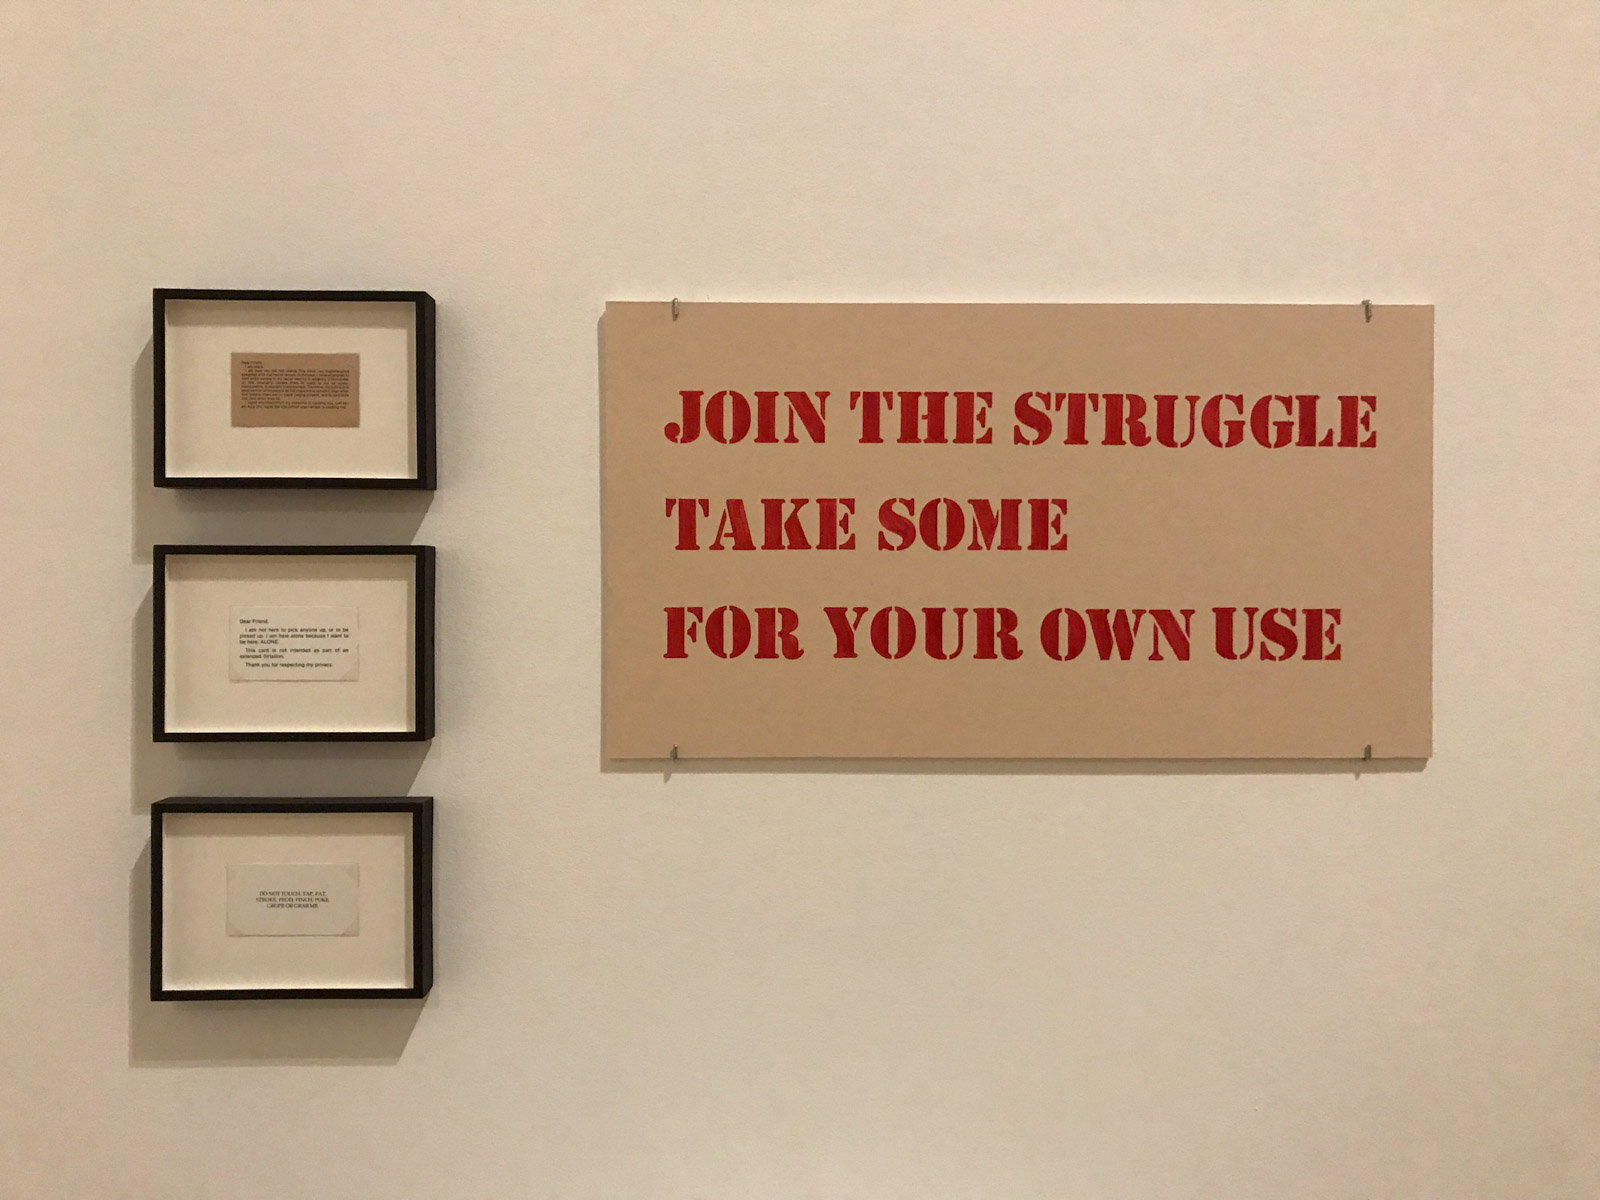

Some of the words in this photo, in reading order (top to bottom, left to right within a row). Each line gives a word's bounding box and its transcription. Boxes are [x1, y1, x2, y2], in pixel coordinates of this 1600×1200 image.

[664, 390, 830, 445] JOIN
[850, 391, 992, 445] THE
[1013, 392, 1377, 448] STRUGGLE
[665, 497, 856, 551] TAKE
[877, 497, 1068, 552] SOME
[663, 606, 804, 660] FOR
[823, 606, 1024, 661] YOUR
[1040, 608, 1196, 662] OWN
[1212, 607, 1342, 662] USE
